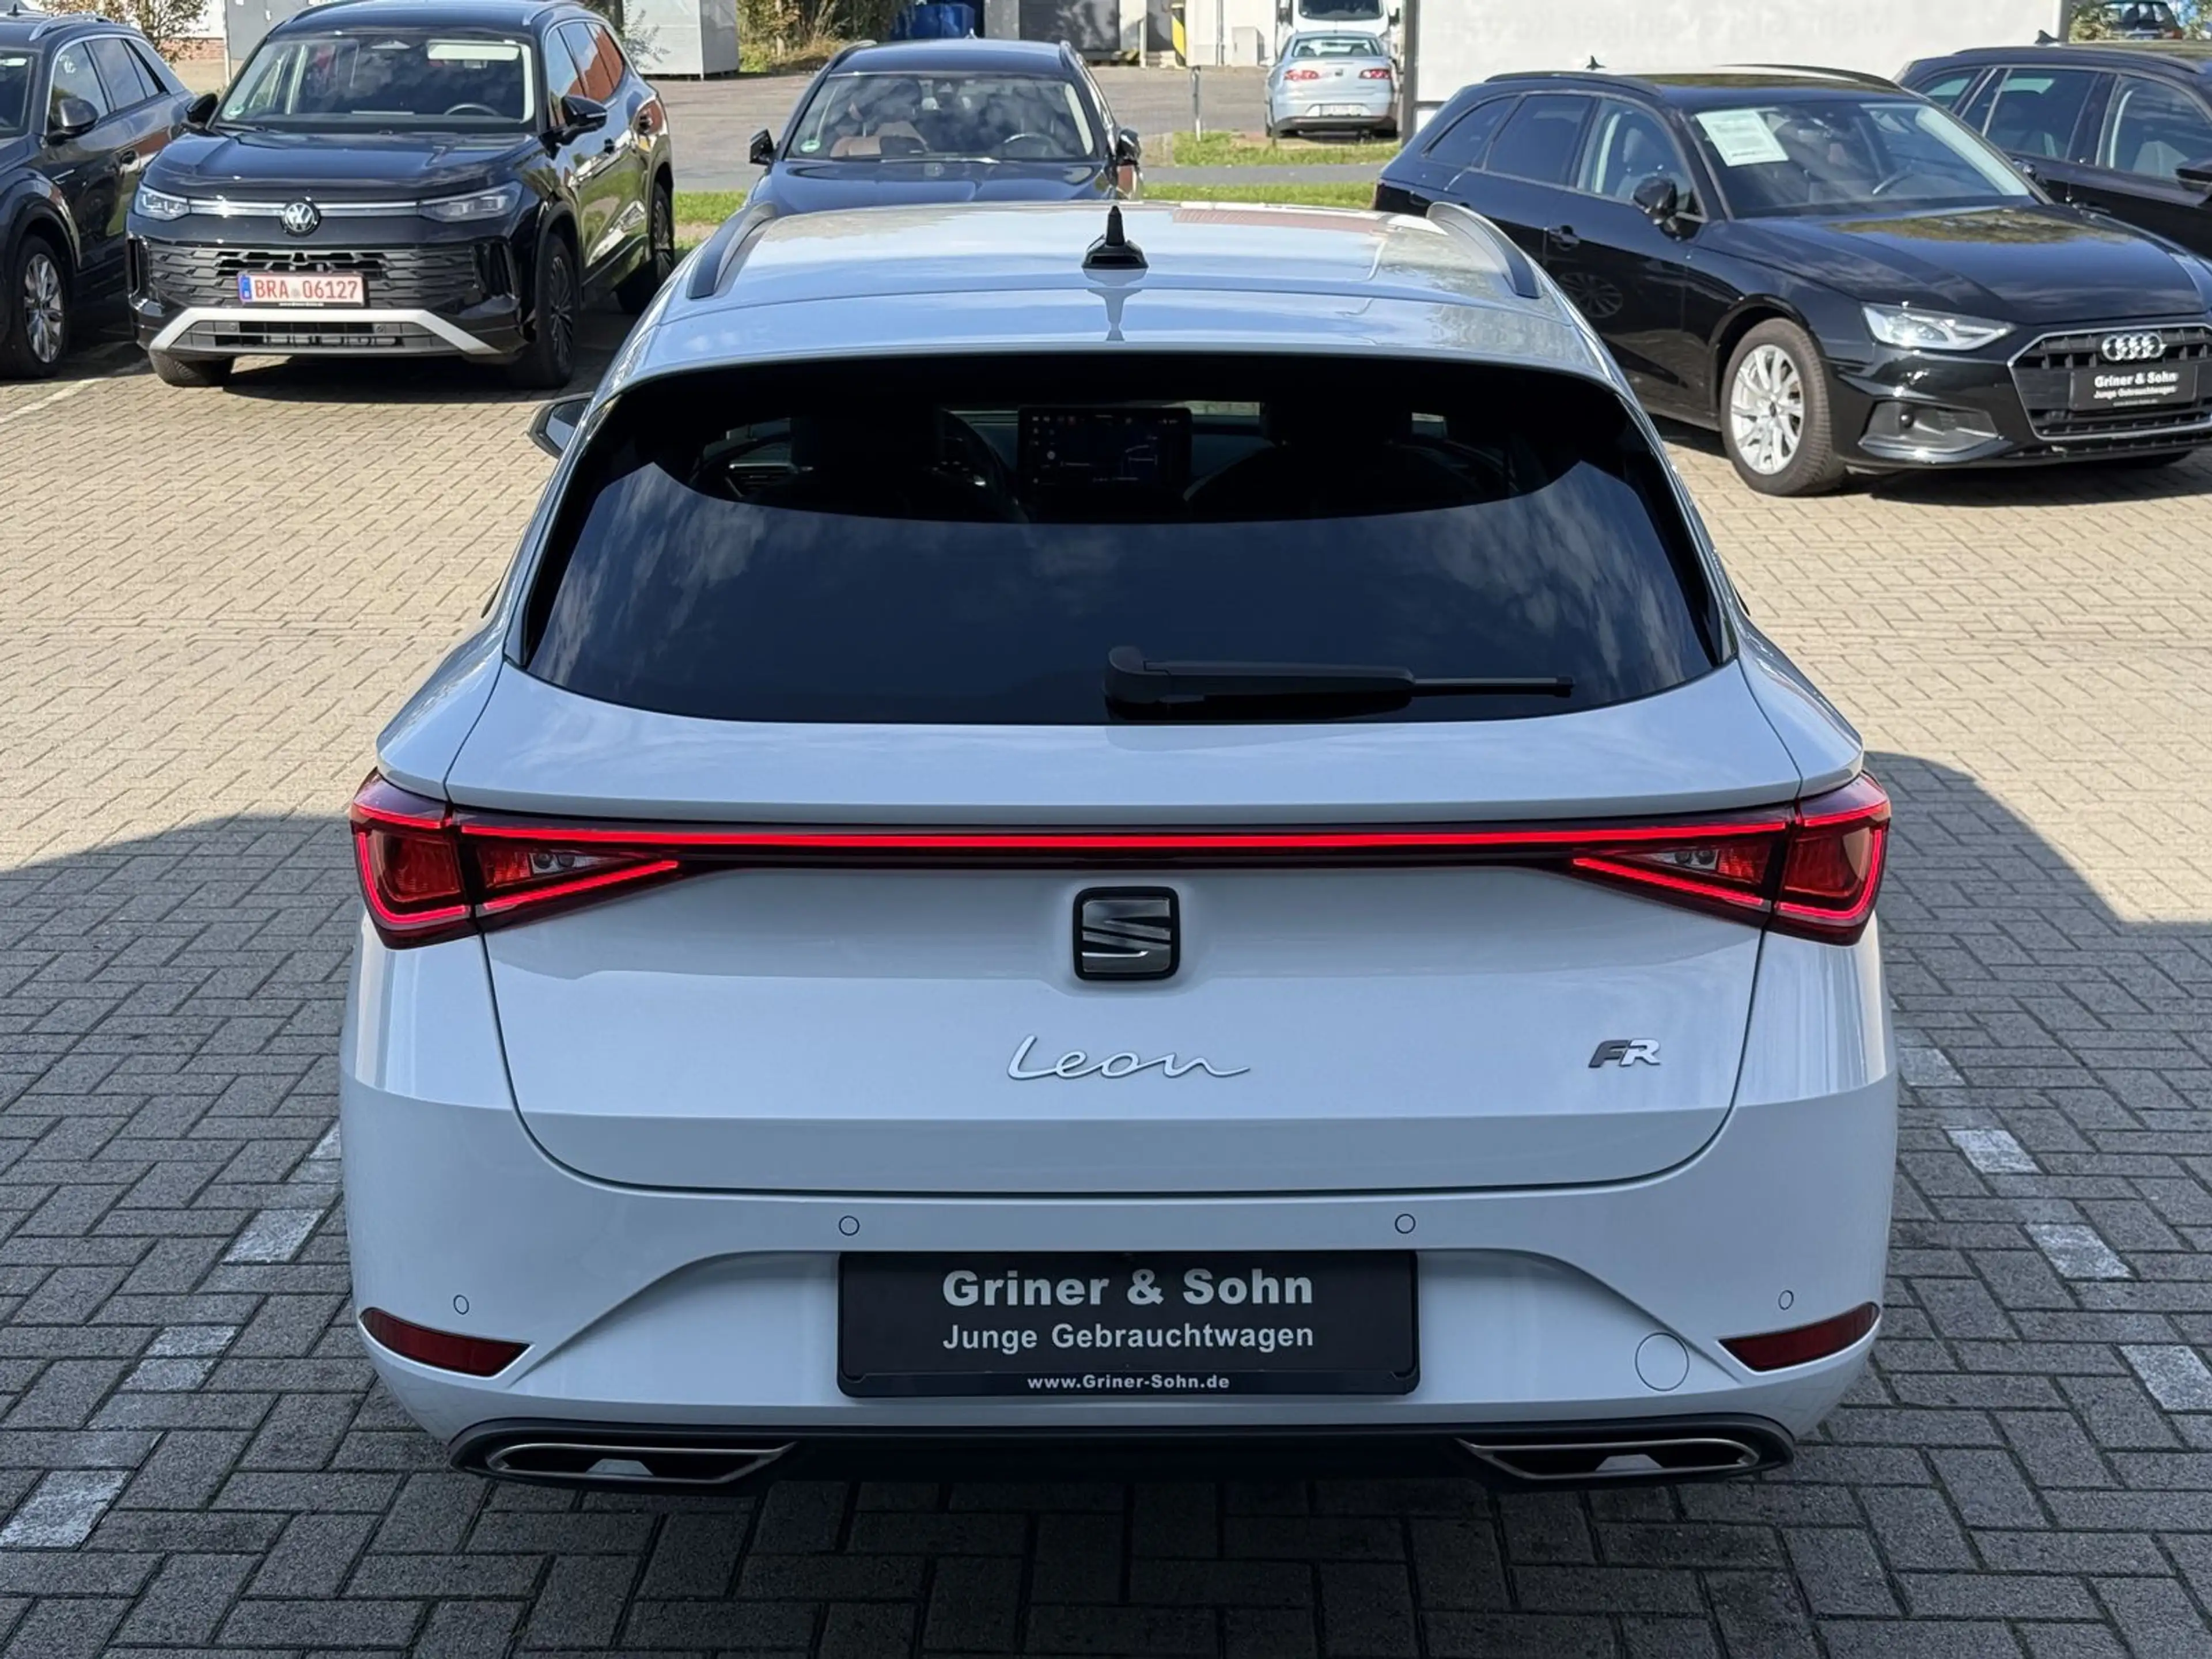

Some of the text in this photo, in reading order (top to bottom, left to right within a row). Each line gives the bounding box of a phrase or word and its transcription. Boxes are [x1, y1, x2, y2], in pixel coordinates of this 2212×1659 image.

[254, 279, 358, 299] BRA 06127
[2094, 370, 2179, 388] Griner & Sohn
[1007, 1034, 1251, 1080] Leon
[1588, 1038, 1661, 1068] FR
[942, 1268, 1313, 1306] Griner & Sohn
[942, 1323, 1314, 1354] Junge Gebrauchtwagen
[1027, 1374, 1230, 1389] www.Griner-Sohn.de
